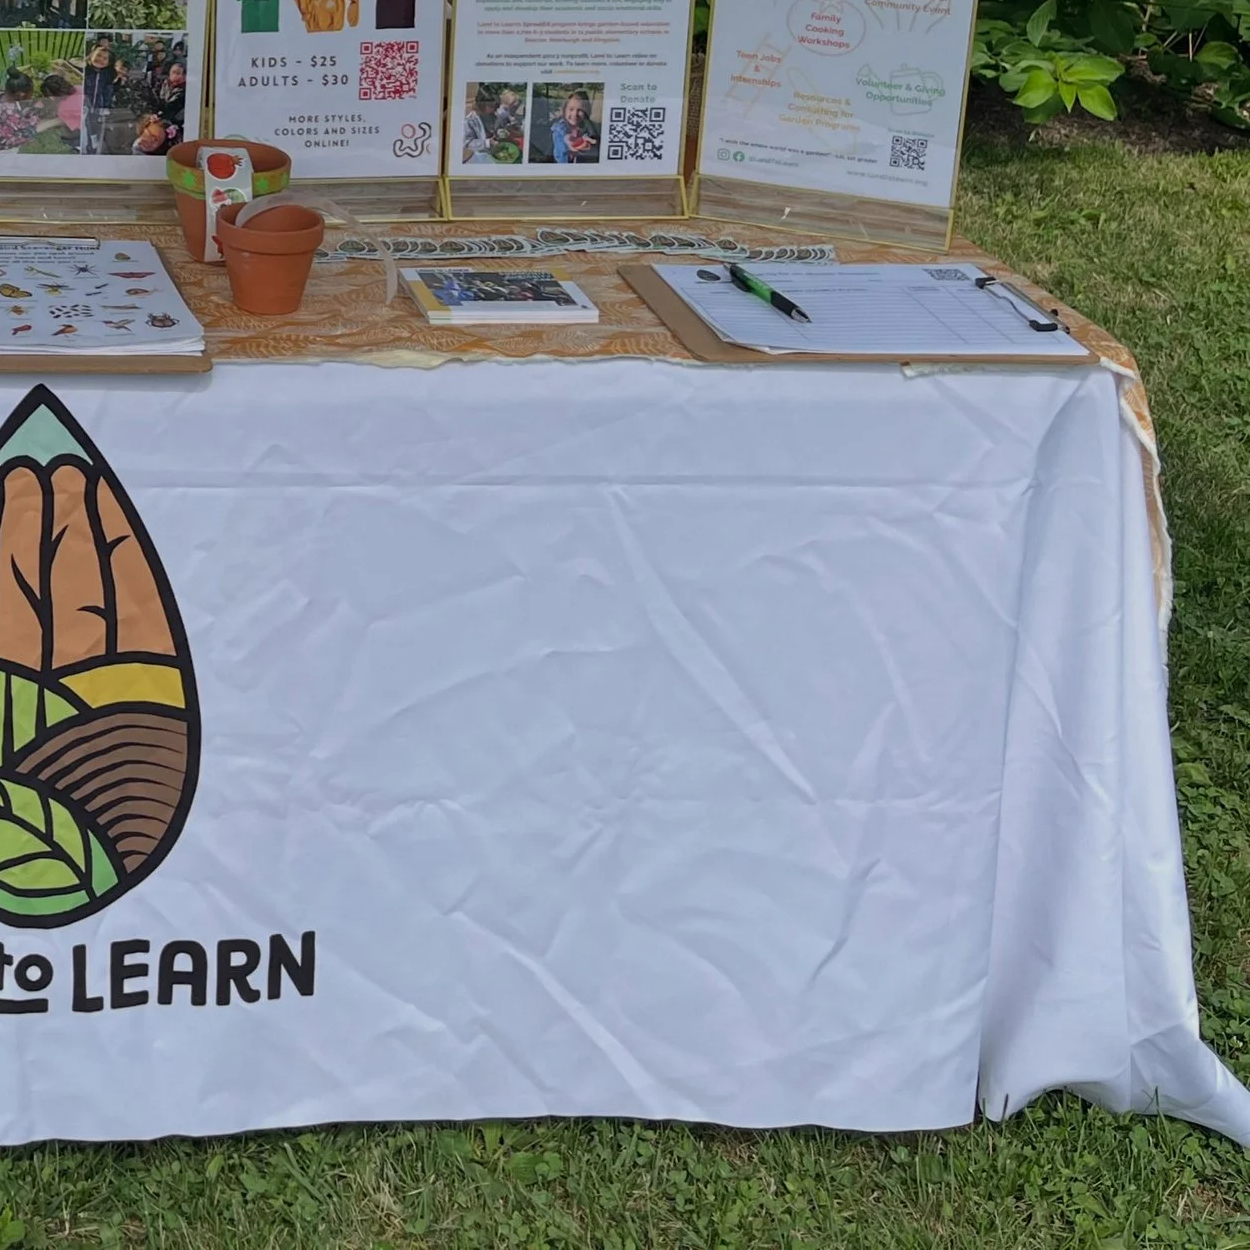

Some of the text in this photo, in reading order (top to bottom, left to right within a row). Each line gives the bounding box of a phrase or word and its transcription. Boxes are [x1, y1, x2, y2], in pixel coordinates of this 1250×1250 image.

[923, 4, 951, 15] Event
[811, 12, 842, 24] Family
[805, 24, 845, 37] Cooking
[797, 35, 851, 49] Workshops
[251, 57, 287, 68] KIDS
[310, 55, 337, 68] $25
[736, 50, 782, 63] Teen Jobs
[238, 75, 298, 87] ADULTS
[322, 74, 349, 86] $30
[620, 83, 658, 91] Scan to
[731, 73, 782, 89] Internships
[856, 78, 945, 97] Volunteer & Giving
[620, 95, 656, 103] Donate
[794, 91, 842, 105] Resources
[865, 91, 933, 107] Opportunities
[788, 103, 854, 119] Consulting for
[289, 115, 319, 123] MORE
[780, 114, 814, 126] Garden
[274, 126, 380, 136] COLORS AND SIZES
[304, 139, 349, 148] ONLINE!
[71, 931, 316, 1012] LEARN
